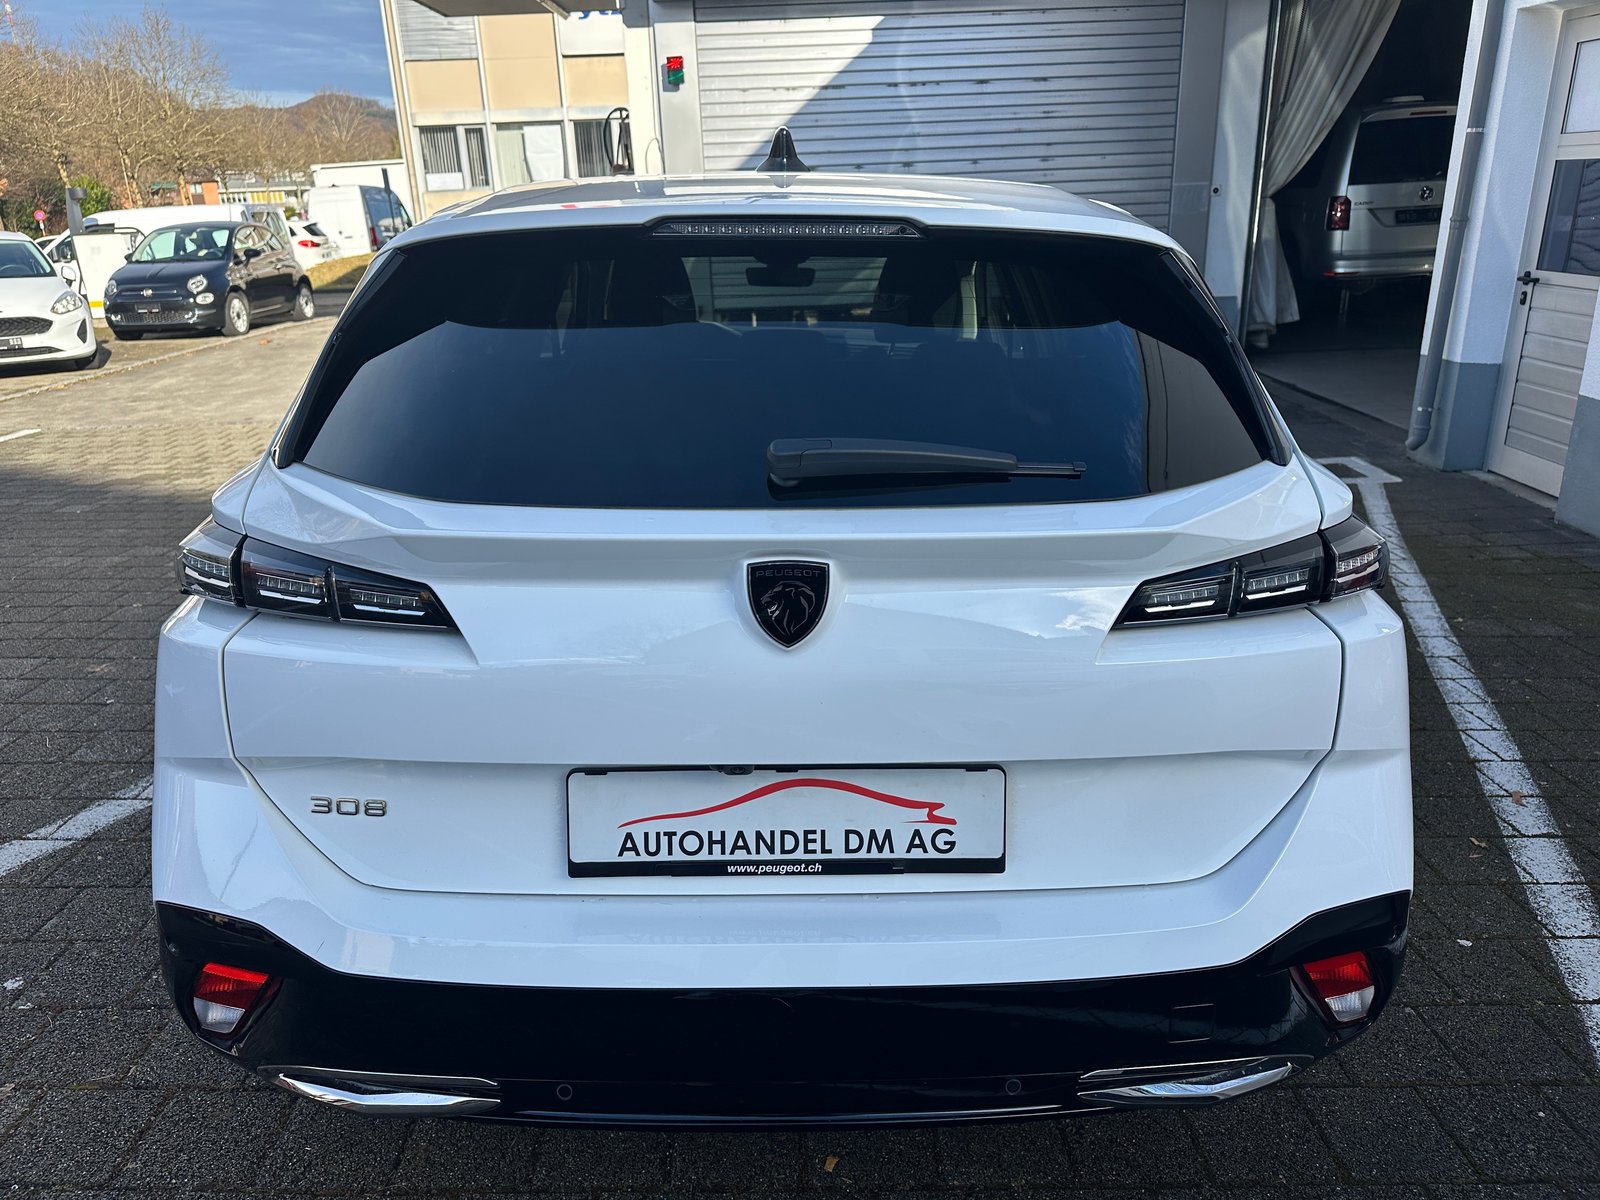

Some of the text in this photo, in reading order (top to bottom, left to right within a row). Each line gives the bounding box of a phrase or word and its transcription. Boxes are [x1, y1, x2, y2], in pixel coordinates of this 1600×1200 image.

[756, 569, 822, 577] PEUGEOT
[311, 796, 387, 817] 308
[617, 828, 957, 858] AUTOHANDEL DM AG
[727, 863, 822, 876] www.peugeot.ch
